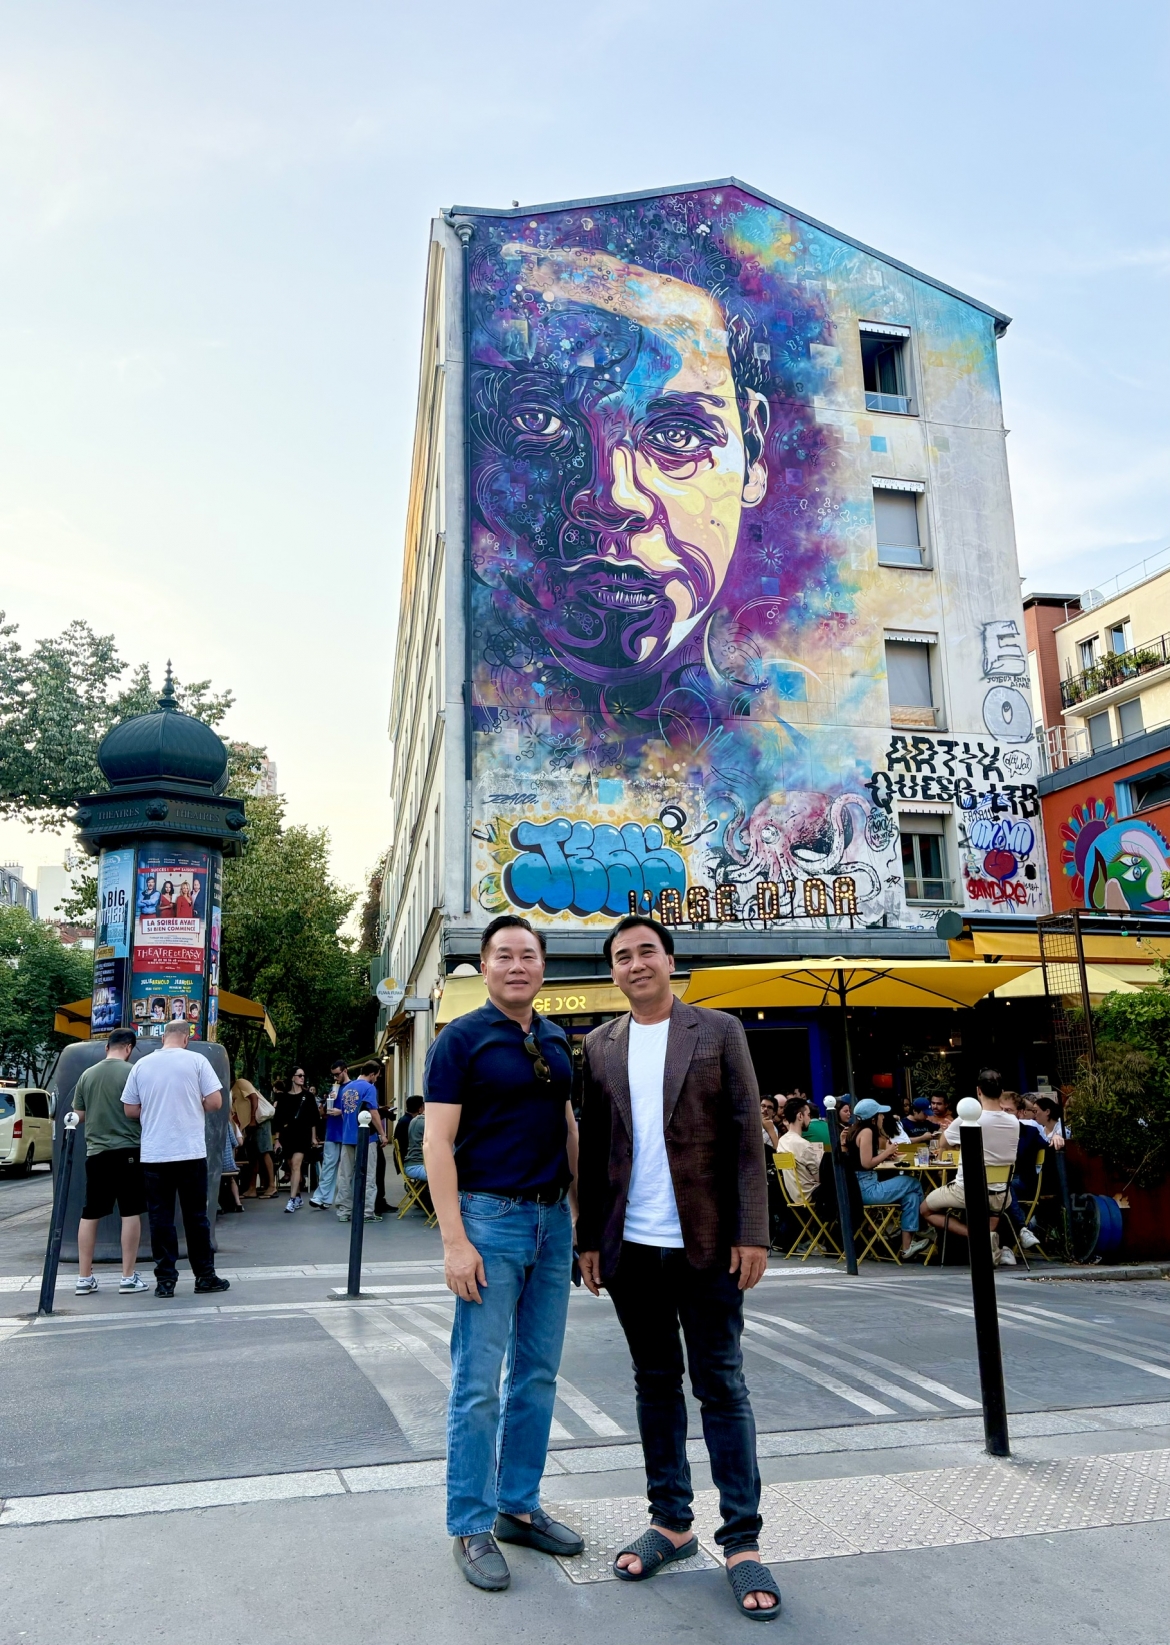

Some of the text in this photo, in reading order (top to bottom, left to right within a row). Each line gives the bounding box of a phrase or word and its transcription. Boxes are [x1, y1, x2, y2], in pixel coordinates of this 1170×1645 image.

[757, 877, 857, 920] D'OR
[180, 919, 196, 927] AVAIT
[532, 998, 551, 1012] GE
